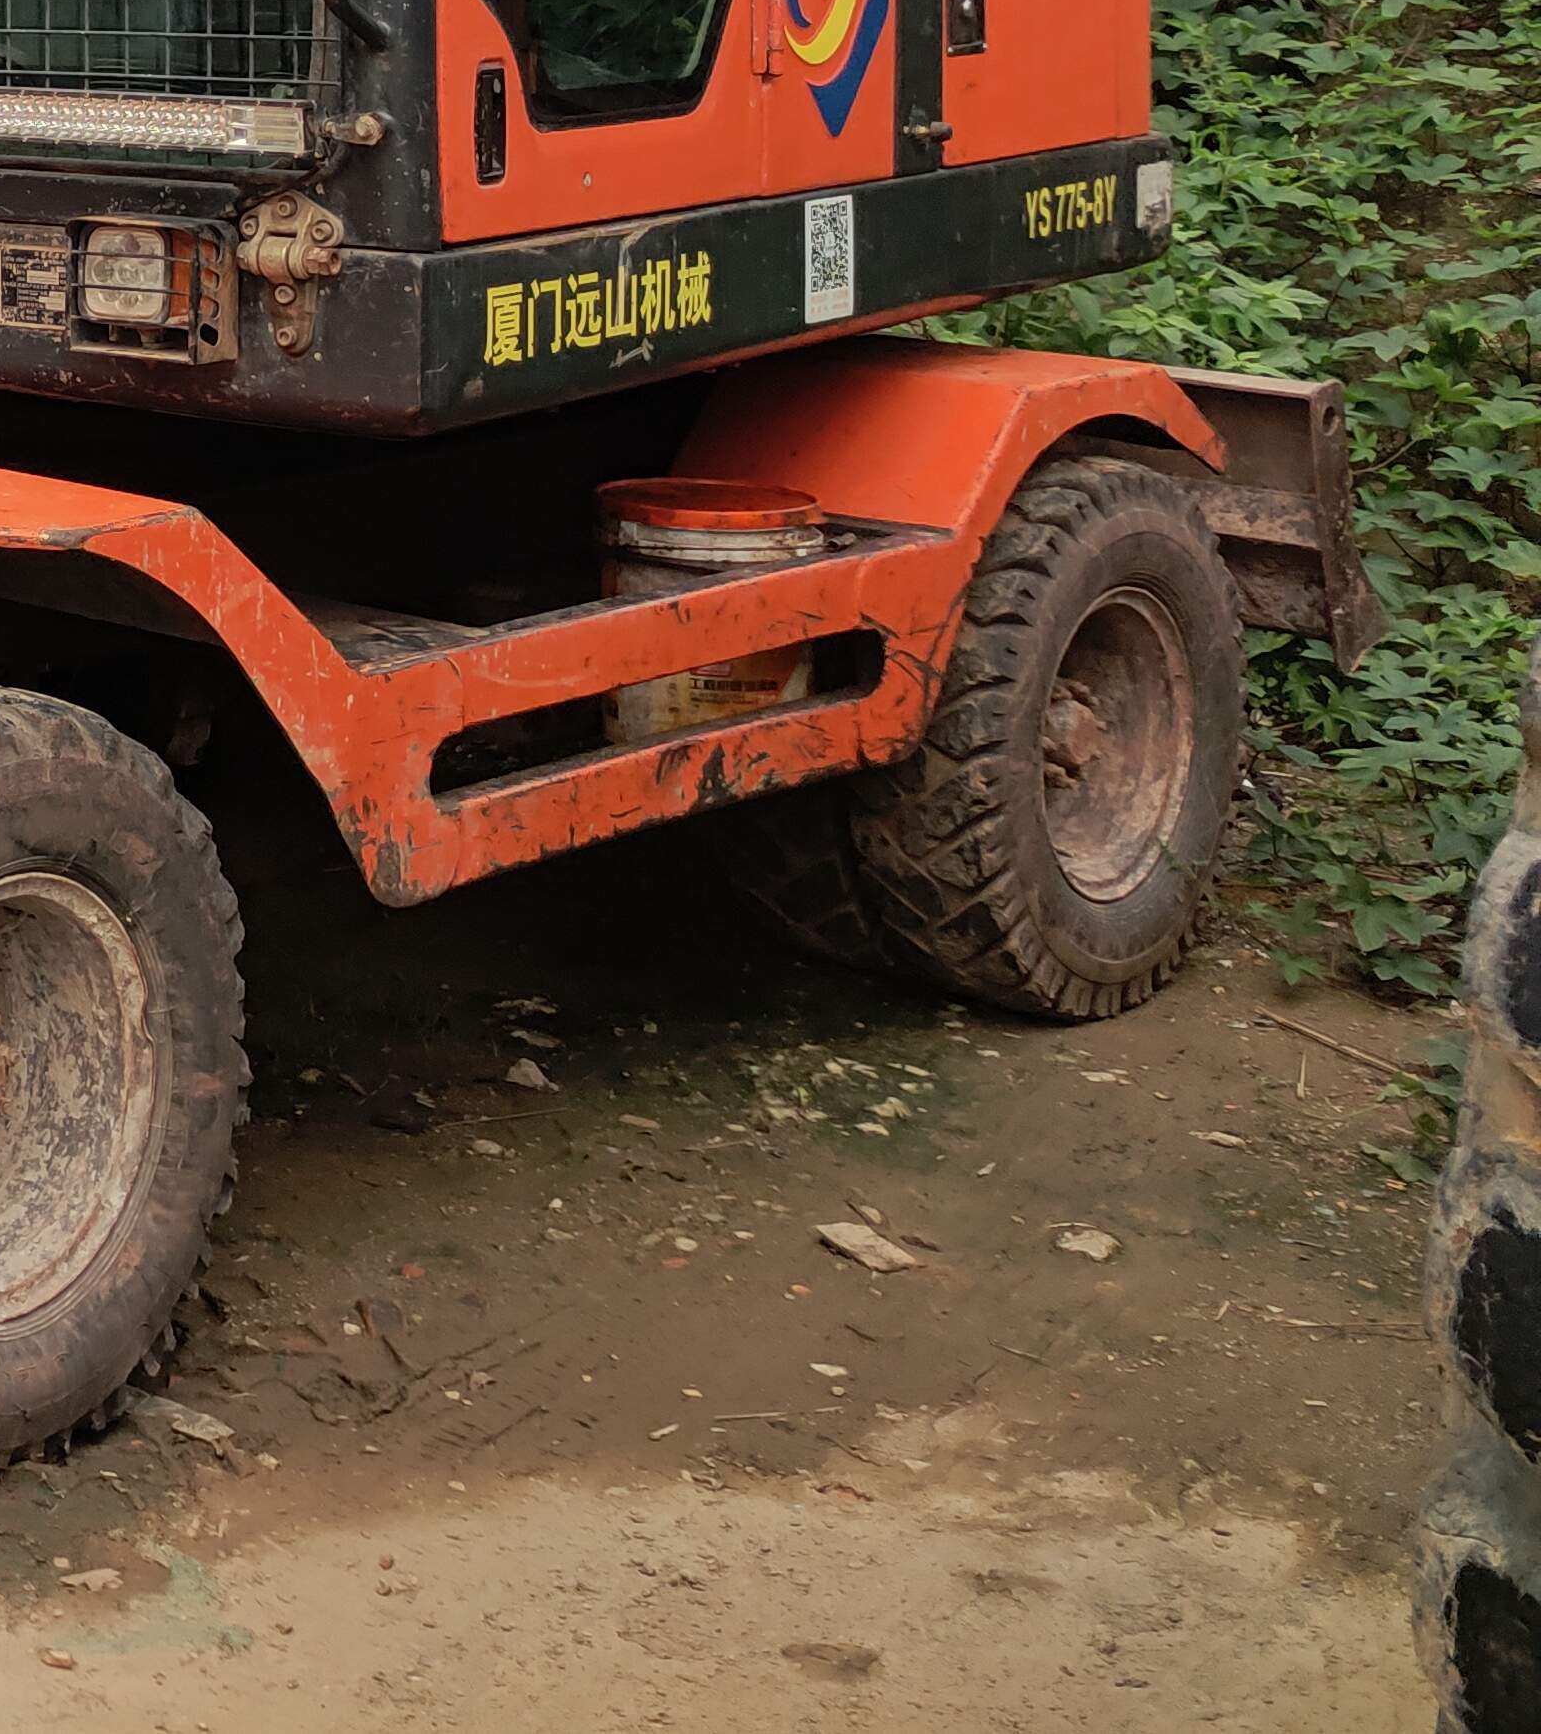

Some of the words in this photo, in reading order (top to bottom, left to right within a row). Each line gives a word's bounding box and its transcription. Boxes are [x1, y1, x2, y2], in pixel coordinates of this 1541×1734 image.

[483, 250, 712, 366] 厦门远山机械
